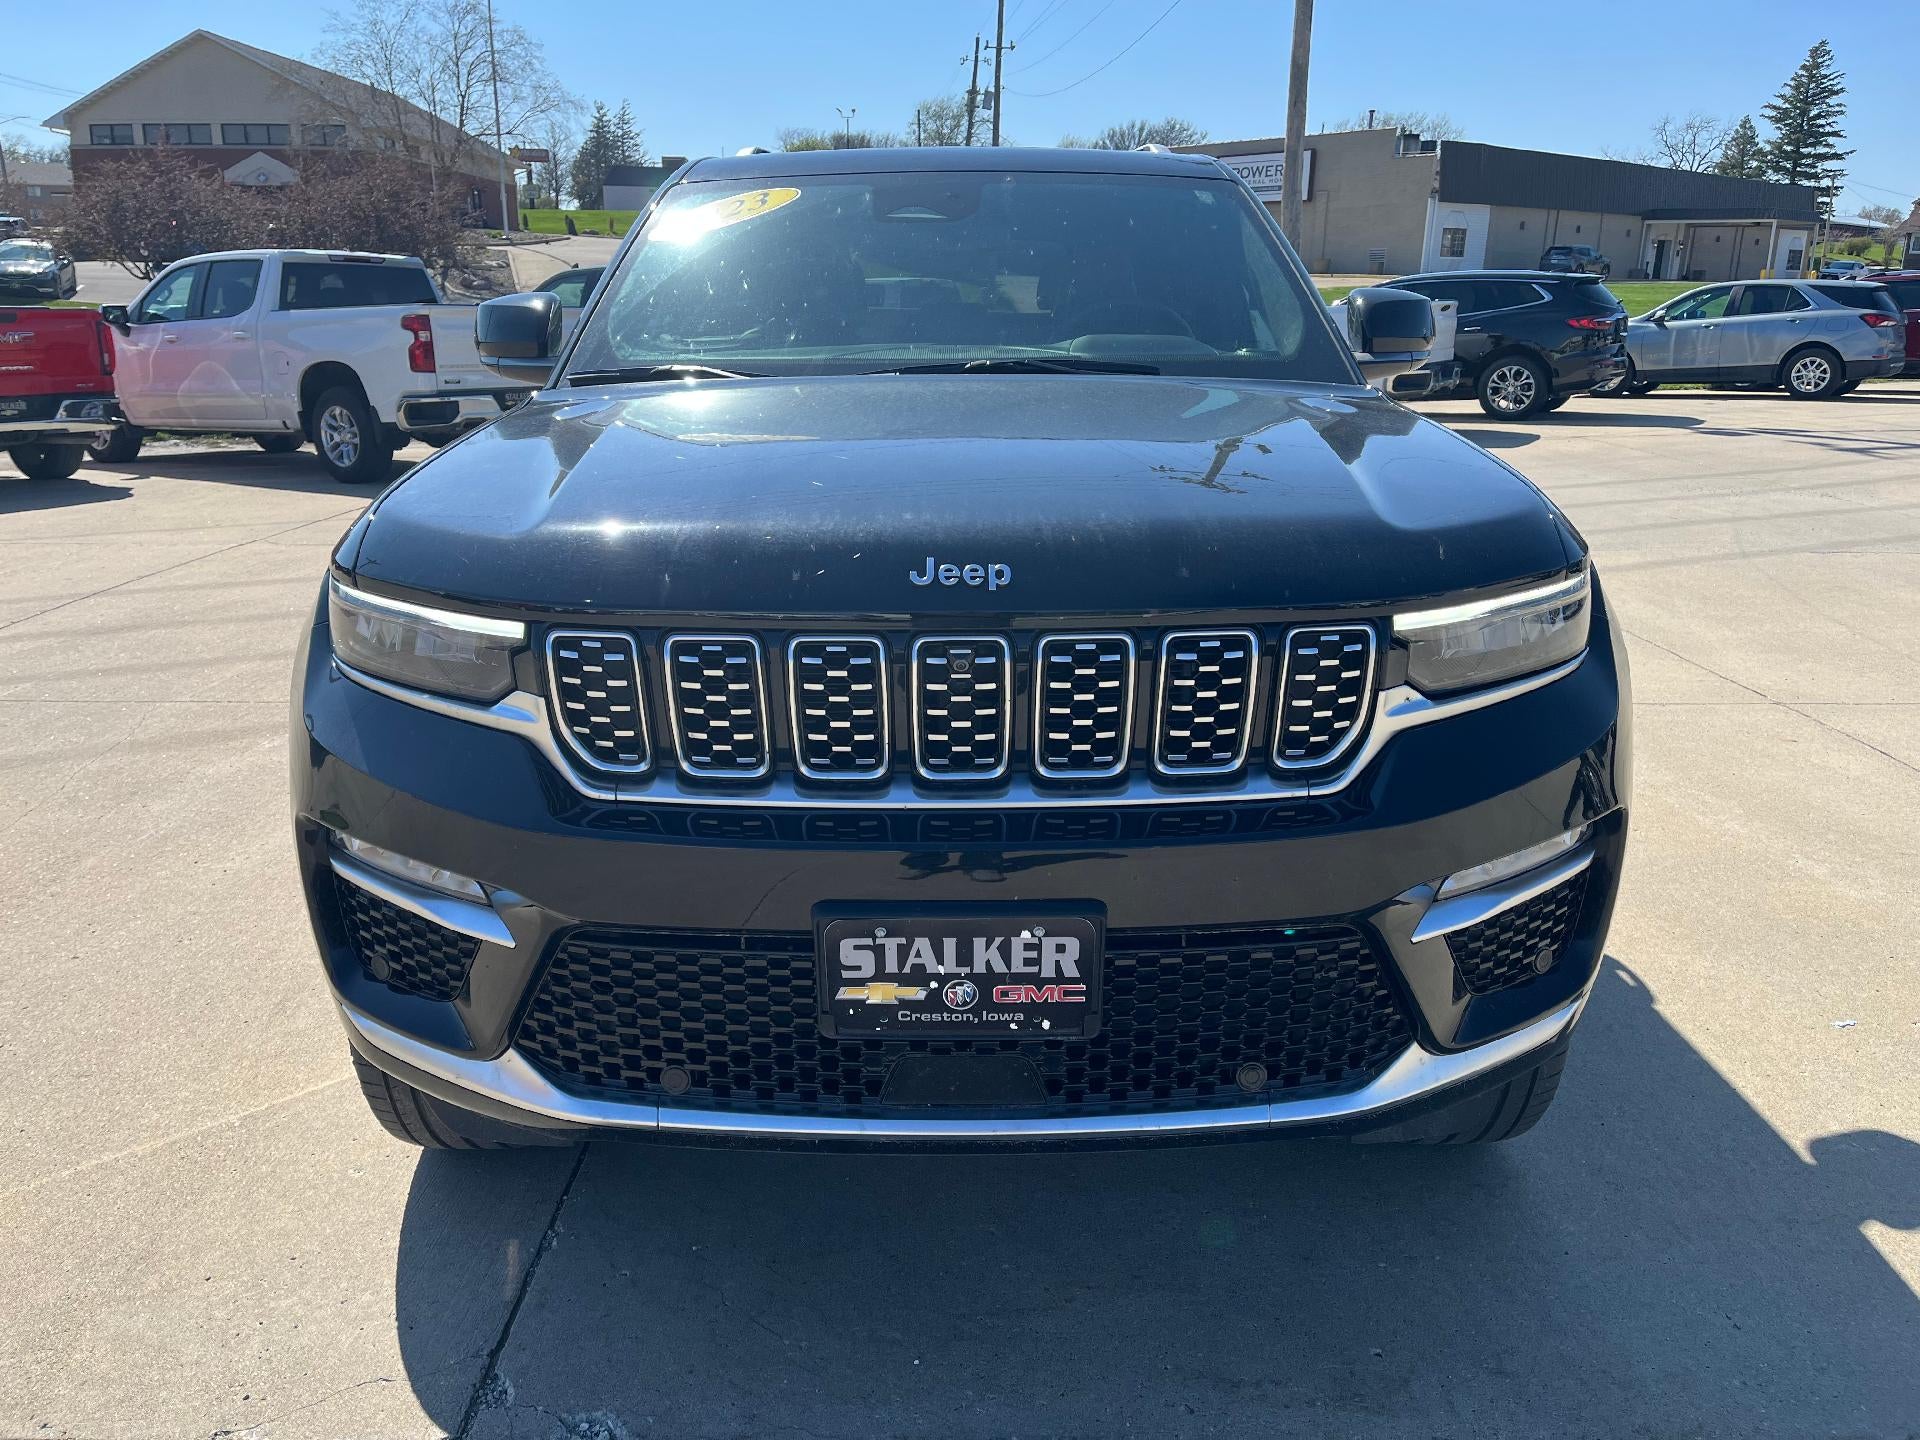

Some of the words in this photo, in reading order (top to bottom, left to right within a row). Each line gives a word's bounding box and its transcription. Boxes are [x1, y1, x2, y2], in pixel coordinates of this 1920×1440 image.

[909, 556, 1012, 591] Jeep
[839, 936, 1081, 979] STALKER
[993, 984, 1086, 1004] GMC
[897, 1010, 979, 1024] Creston,
[982, 1011, 1024, 1022] Iowa
